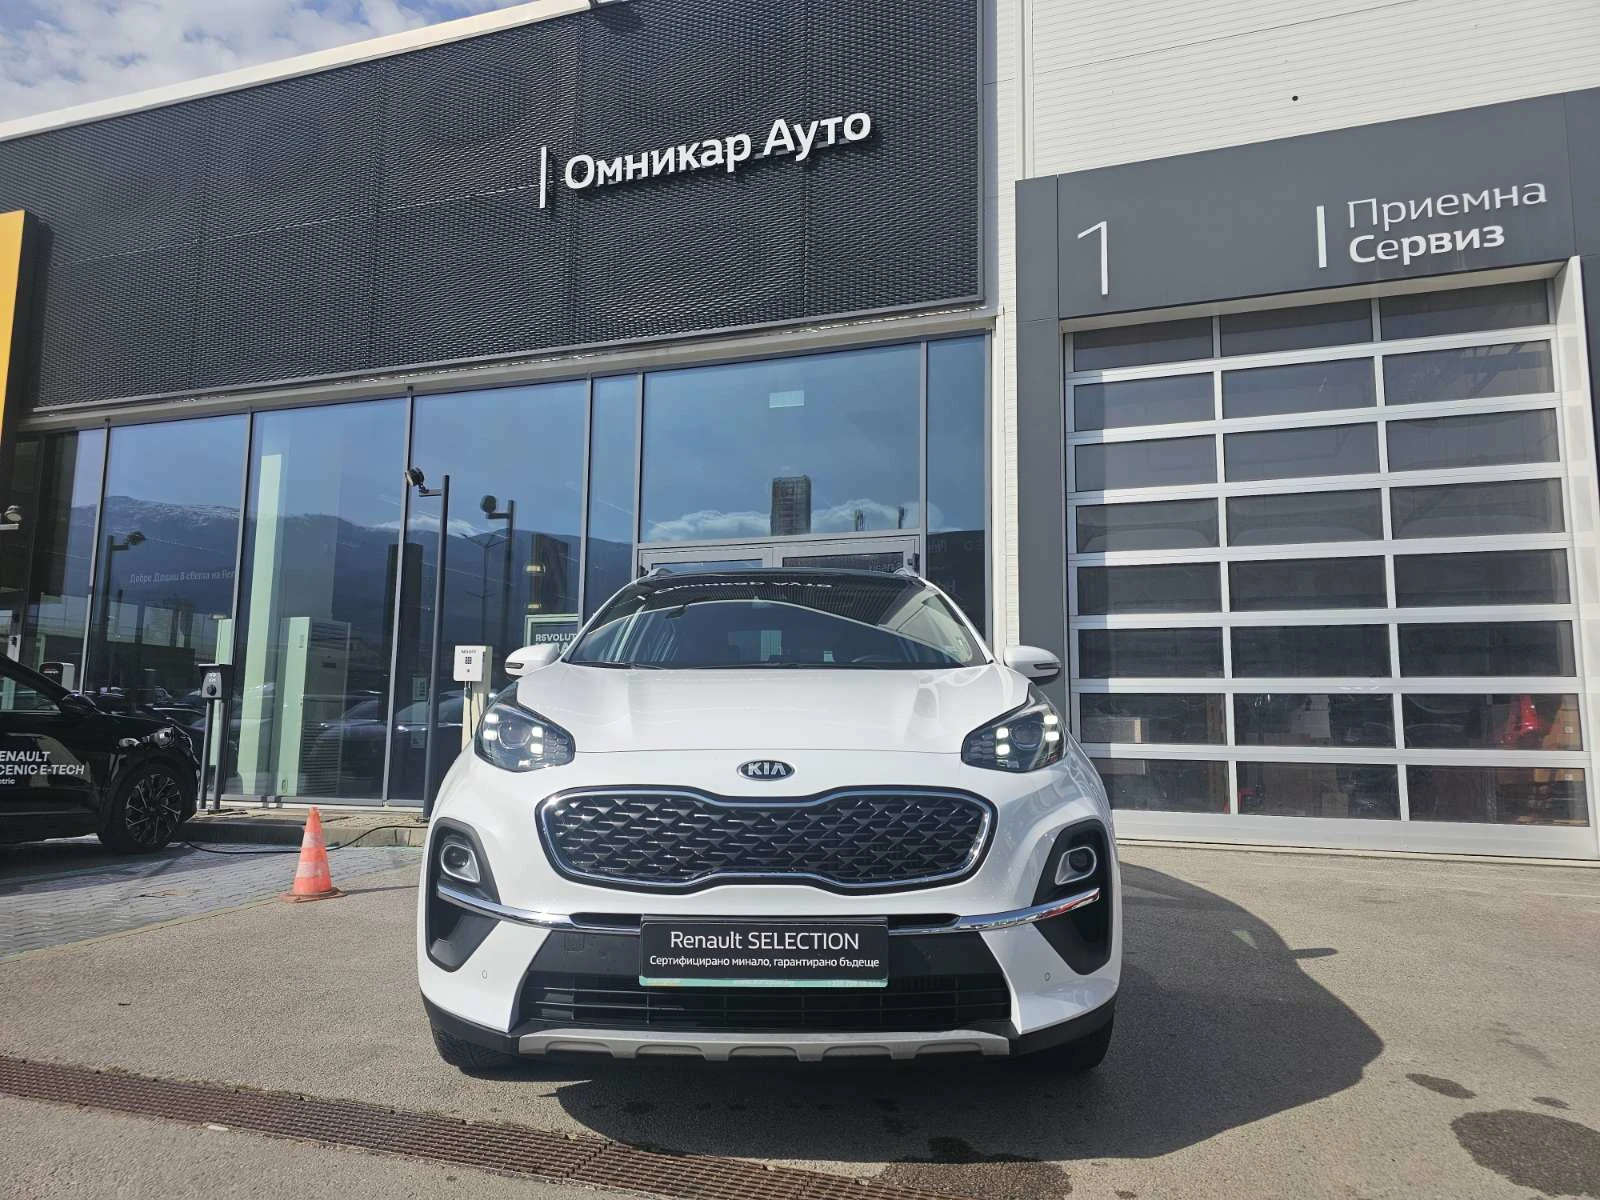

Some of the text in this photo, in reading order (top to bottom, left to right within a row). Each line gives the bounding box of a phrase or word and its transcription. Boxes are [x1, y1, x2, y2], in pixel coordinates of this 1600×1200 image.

[564, 112, 871, 189] Омникар Ауто
[1347, 182, 1548, 232] Приемна
[1348, 224, 1506, 266] Сервиз
[1077, 220, 1109, 296] 1
[0, 750, 51, 762] ENAULT
[0, 764, 85, 776] CENIC E-TECH
[748, 762, 787, 776] KIA
[670, 931, 859, 950] Renault SELECTION
[649, 955, 880, 969] Сертифицирано минало, гарантирано бъдеще
